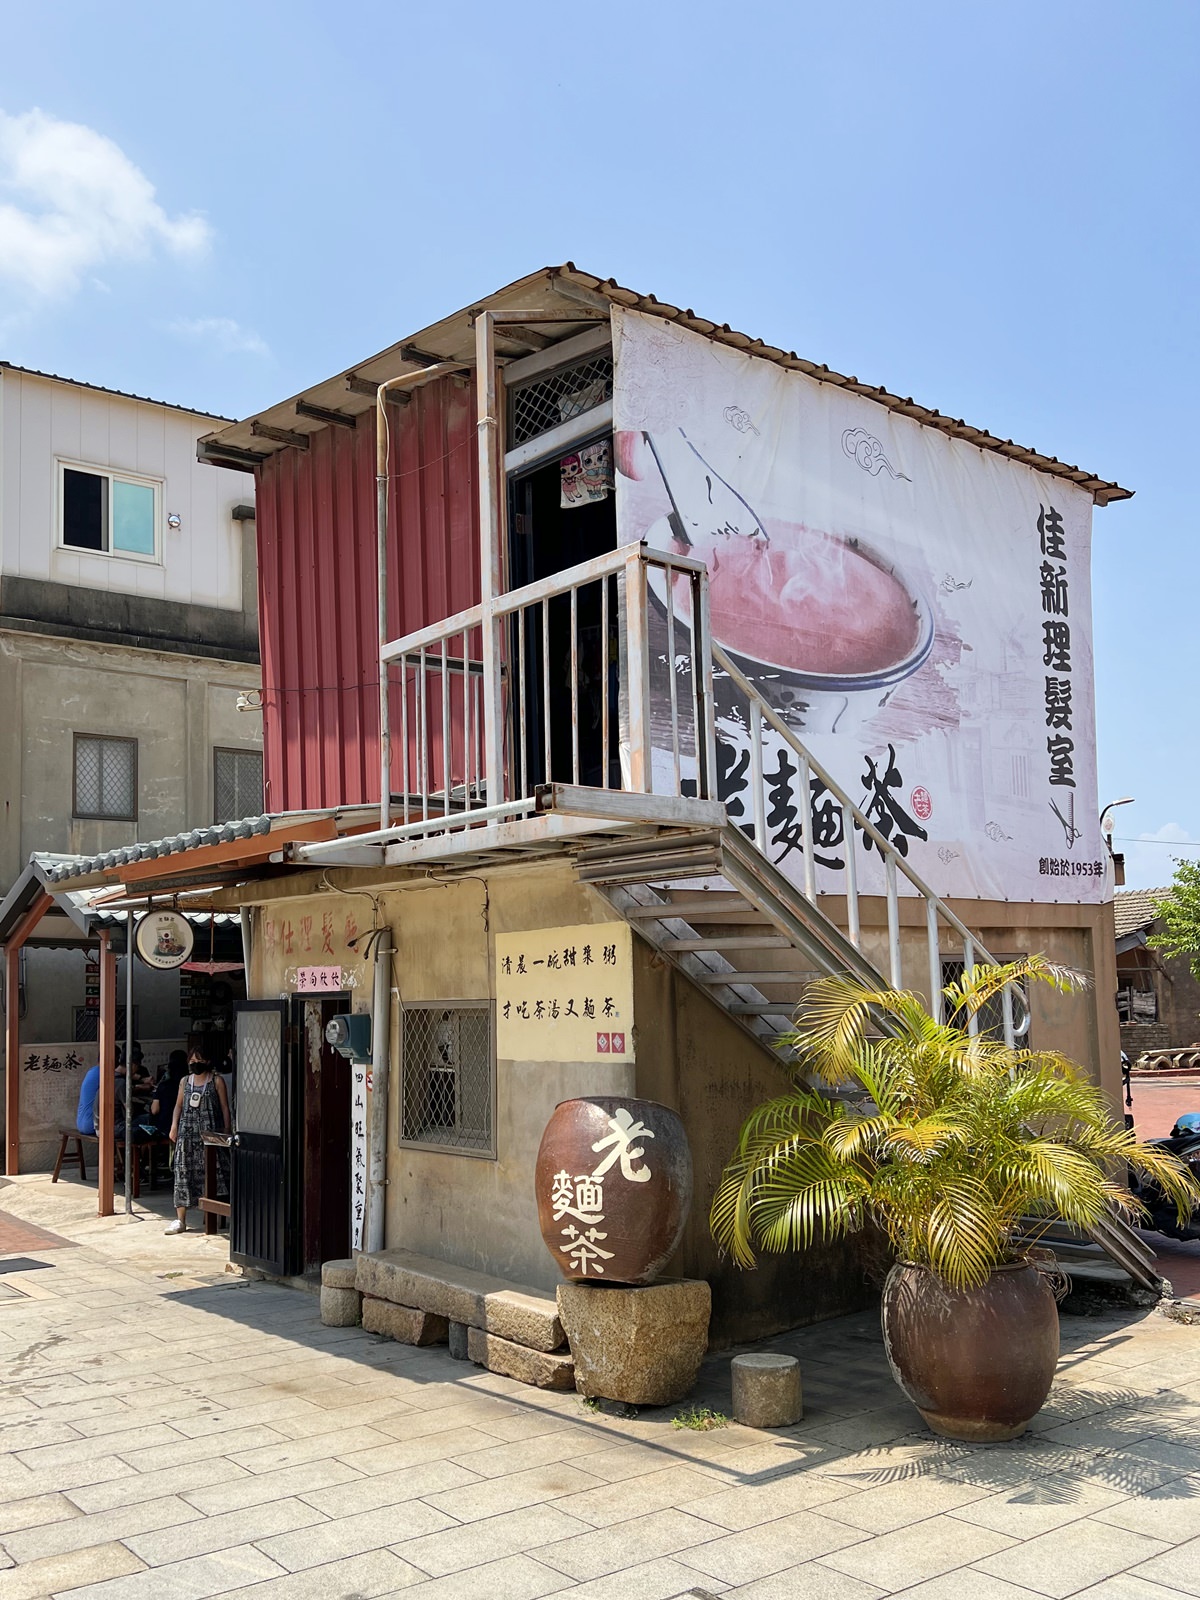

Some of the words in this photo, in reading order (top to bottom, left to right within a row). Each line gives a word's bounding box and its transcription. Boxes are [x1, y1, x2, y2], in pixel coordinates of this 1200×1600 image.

[1036, 503, 1077, 788] 佳新理髮室
[1038, 857, 1104, 877] 創始於1953年
[23, 1050, 82, 1073] 老麵茶
[551, 1107, 655, 1275] 老麵茶
